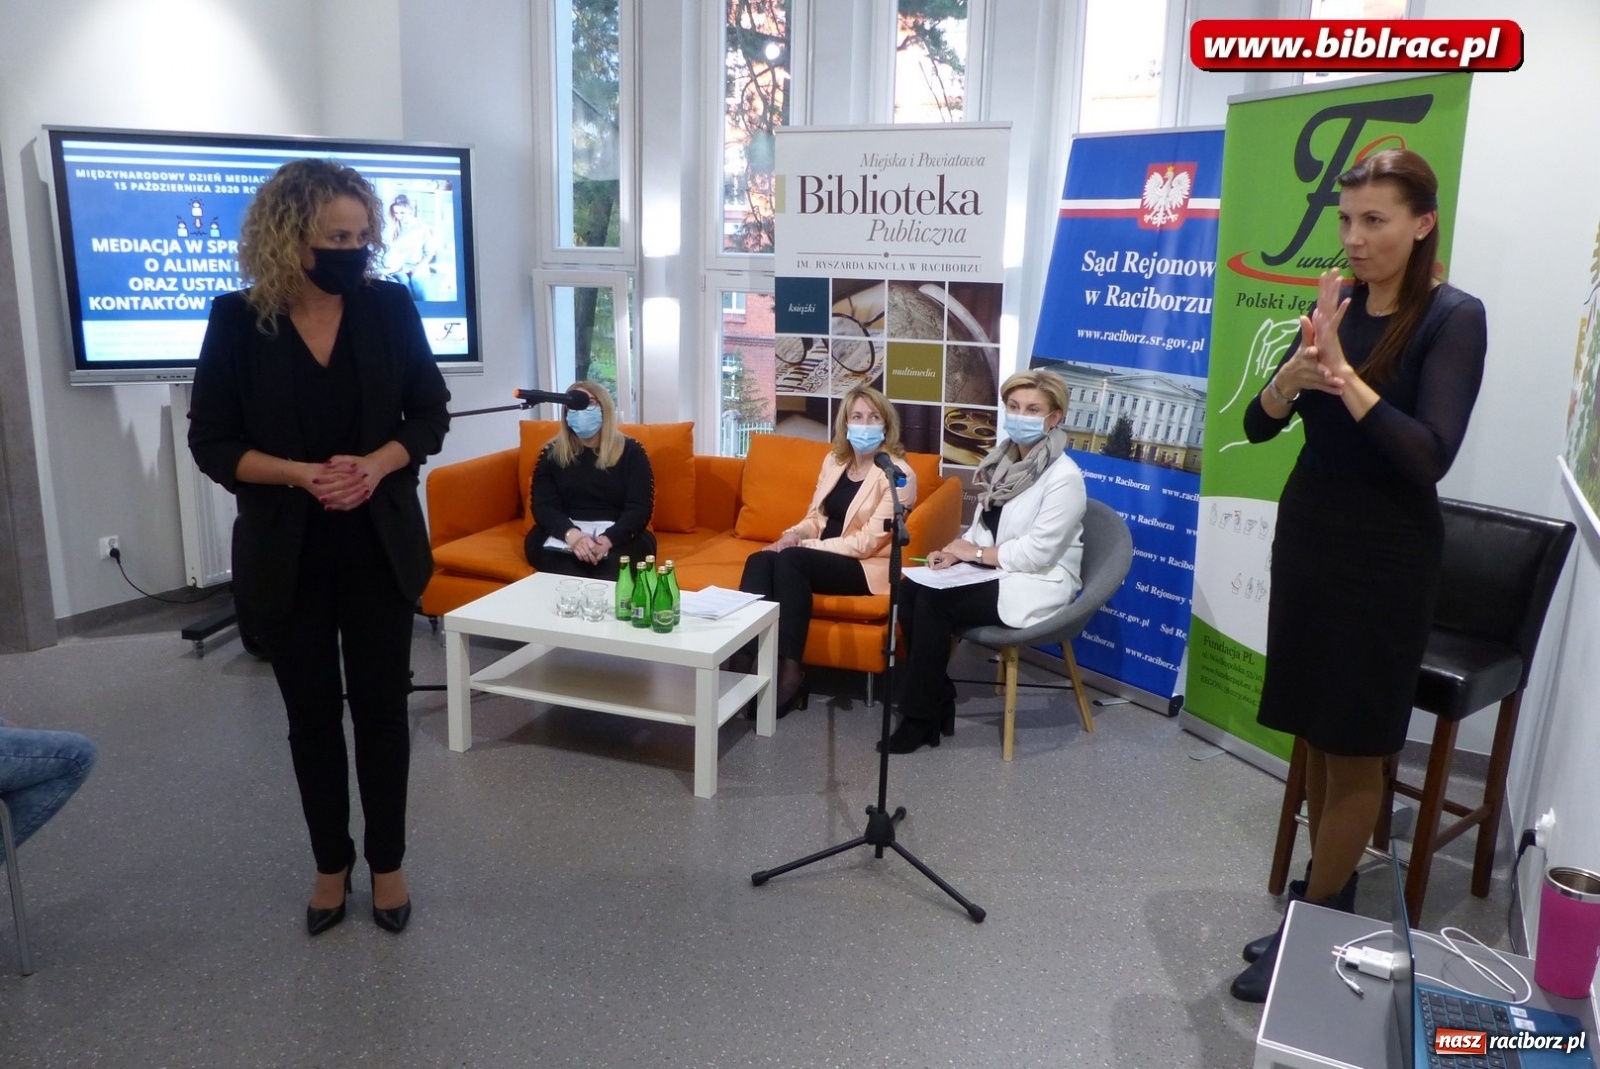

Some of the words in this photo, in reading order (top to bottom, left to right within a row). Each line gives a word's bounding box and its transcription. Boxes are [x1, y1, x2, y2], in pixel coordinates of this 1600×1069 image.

[859, 153, 907, 171] Miejska
[909, 154, 914, 168] i
[917, 152, 986, 168] Powiatowa
[75, 169, 185, 182] MIĘDZYNARODOWY
[189, 171, 222, 183] DZIEŃ
[114, 182, 127, 191] 15
[131, 181, 212, 193] PAŹDZIERNIKA
[215, 185, 240, 194] 2020
[796, 173, 984, 216] Biblioteka
[866, 218, 967, 246] Publiczna
[91, 237, 182, 256] MEDIACJA
[184, 239, 203, 254] W
[144, 258, 159, 272] O
[796, 260, 811, 269] IM.
[815, 260, 865, 270] RYSZARDA
[867, 261, 905, 271] KINCLA
[908, 262, 917, 271] W
[921, 262, 982, 273] RACIBORZU
[1081, 250, 1119, 277] Sąd
[128, 276, 179, 291] ORAZ
[88, 293, 206, 311] KONTAKTÓW
[1084, 289, 1101, 306] w
[1104, 284, 1213, 315] Raciborzu
[1235, 291, 1285, 310] Polski
[788, 303, 817, 315] książki
[1077, 327, 1205, 352] www.raciborz.sr.gov.pl
[891, 366, 936, 378] multimedia
[1115, 475, 1151, 491] Raciborzu
[1137, 514, 1175, 531] Raciborzu
[1135, 581, 1149, 593] Sąd
[1150, 585, 1187, 605] Rejonowy
[1160, 623, 1174, 636] Sąd
[1081, 630, 1115, 649] Raciborzu
[1203, 634, 1241, 660] Fundacja
[1242, 650, 1256, 666] PL
